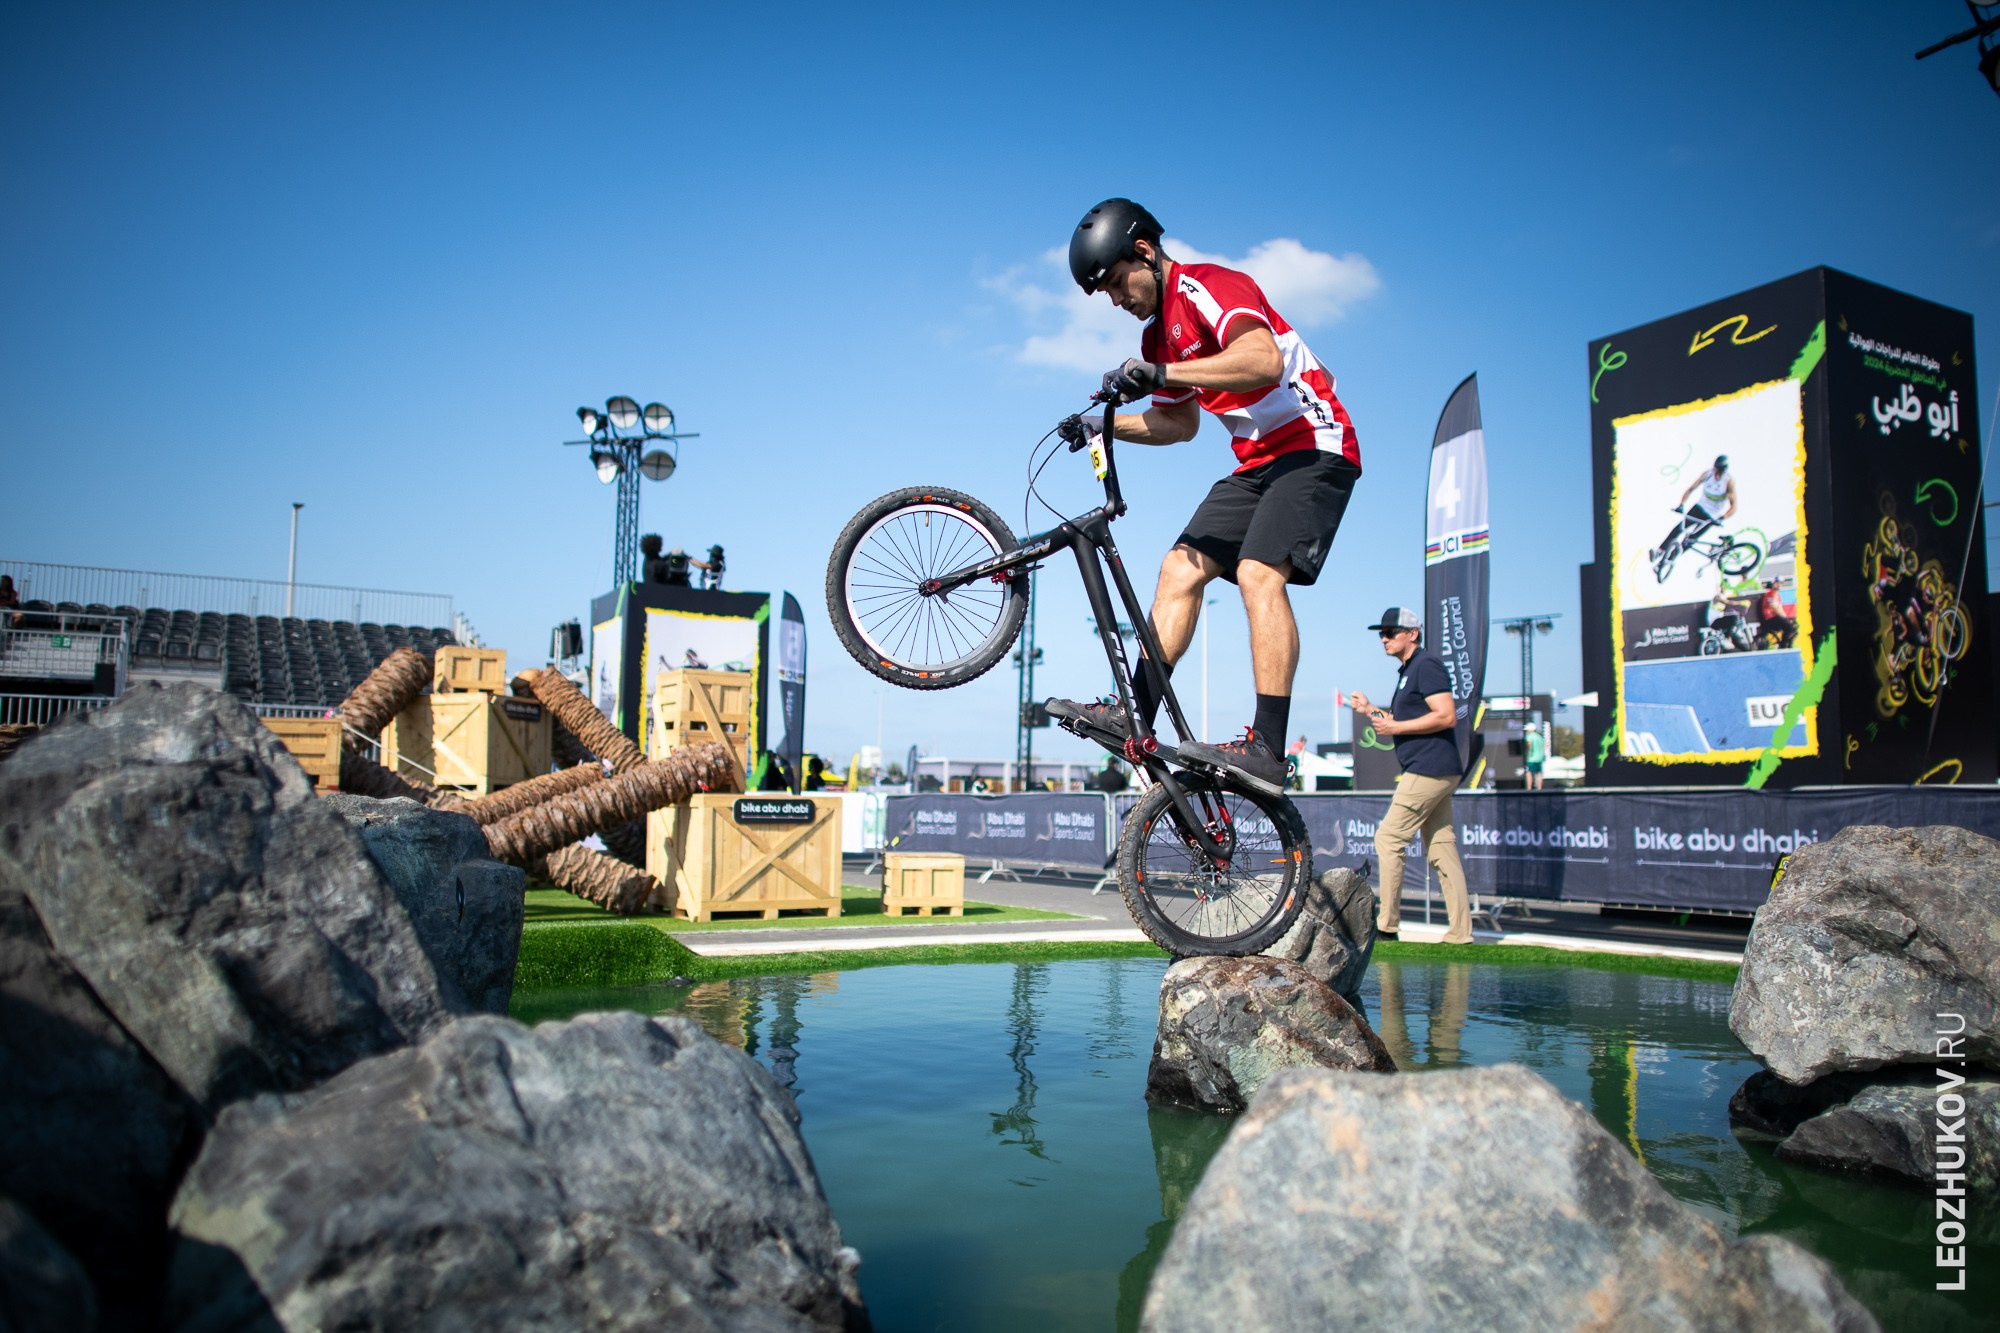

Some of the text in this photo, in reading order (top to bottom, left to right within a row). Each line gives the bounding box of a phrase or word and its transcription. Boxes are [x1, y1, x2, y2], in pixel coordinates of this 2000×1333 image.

[1873, 383, 1959, 441] أبو ظبي
[1436, 455, 1462, 519] 4
[1448, 596, 1467, 650] Council
[741, 802, 809, 814] bike abu dhabi
[916, 810, 957, 824] Abu Dhabi
[986, 811, 1026, 825] Abu Dhabi
[1054, 812, 1095, 827] Abu Dhabi
[916, 824, 957, 835] Sports Council
[987, 826, 1026, 838] Sports Council
[1054, 828, 1095, 841] Sports Council
[1347, 819, 1375, 838] Abu
[1462, 824, 1609, 849] bike abu dhabi
[1635, 827, 1684, 850] bike
[1687, 827, 1736, 852] abu
